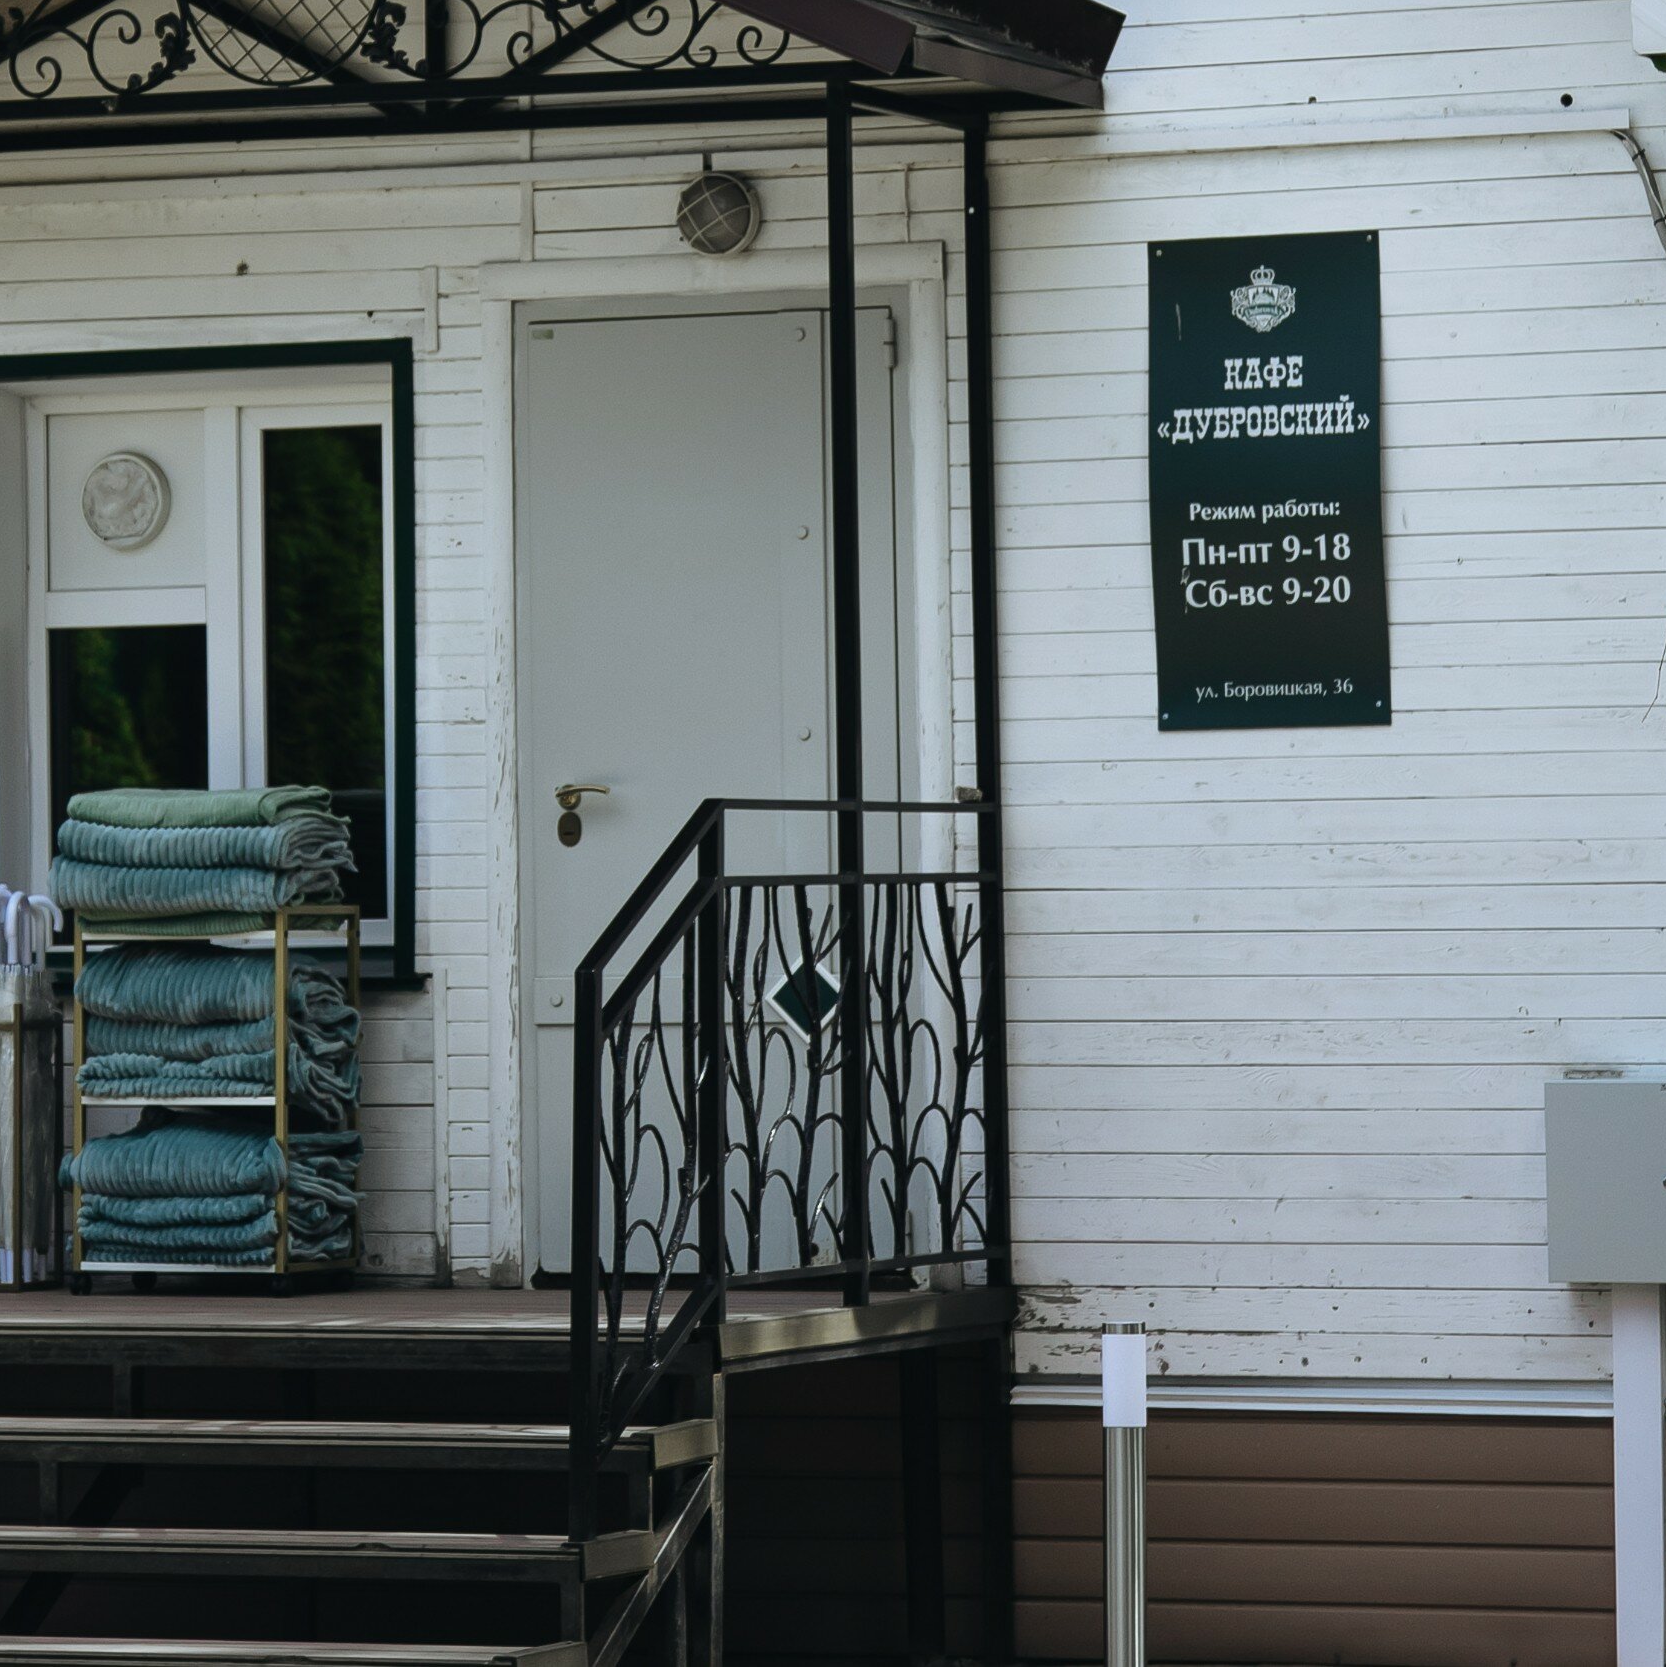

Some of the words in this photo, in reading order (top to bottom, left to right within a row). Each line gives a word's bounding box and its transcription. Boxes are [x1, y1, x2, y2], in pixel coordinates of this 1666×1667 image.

[1223, 355, 1303, 390] КАФЕ
[1157, 394, 1370, 445] «ДУБРОВСКИЙ»
[1189, 502, 1256, 521] Режим
[1262, 499, 1340, 524] работы:
[1182, 538, 1273, 566] Пн-пт
[1282, 533, 1351, 563] 9-18
[1185, 579, 1273, 608] Сб-вс
[1282, 575, 1351, 605] 9-20
[1195, 685, 1218, 703] ул.
[1224, 682, 1328, 701] Боровицкая,
[1333, 678, 1353, 695] 36
